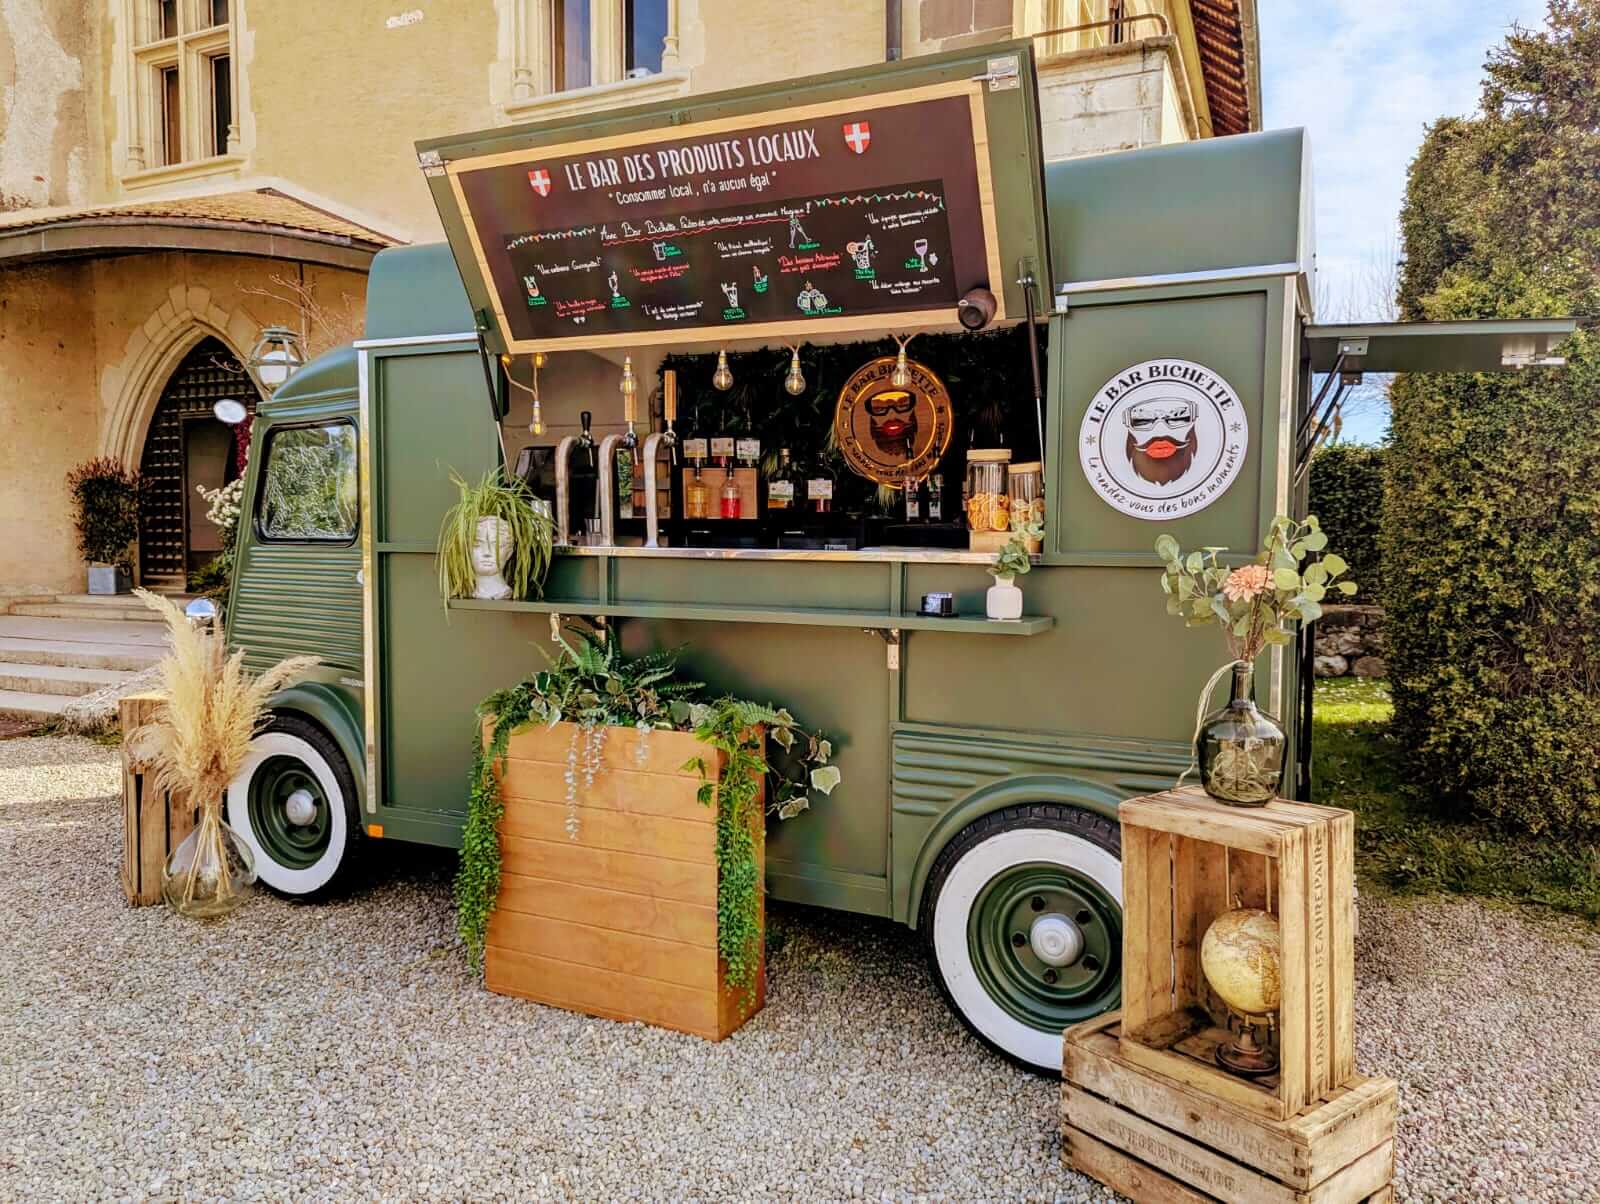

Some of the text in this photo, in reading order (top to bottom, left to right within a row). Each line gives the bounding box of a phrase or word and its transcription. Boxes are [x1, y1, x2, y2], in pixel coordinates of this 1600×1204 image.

[564, 128, 821, 191] LE BAR DES PRODUITS LOCAUX
[616, 188, 667, 205] Consommer
[718, 175, 747, 192] aucun
[750, 171, 770, 193] égal
[1089, 364, 1235, 424] LE BAR BICHETTE
[1088, 457, 1100, 470] Le
[1157, 501, 1179, 513] des
[1180, 492, 1207, 509] bons
[1206, 443, 1240, 494] moments
